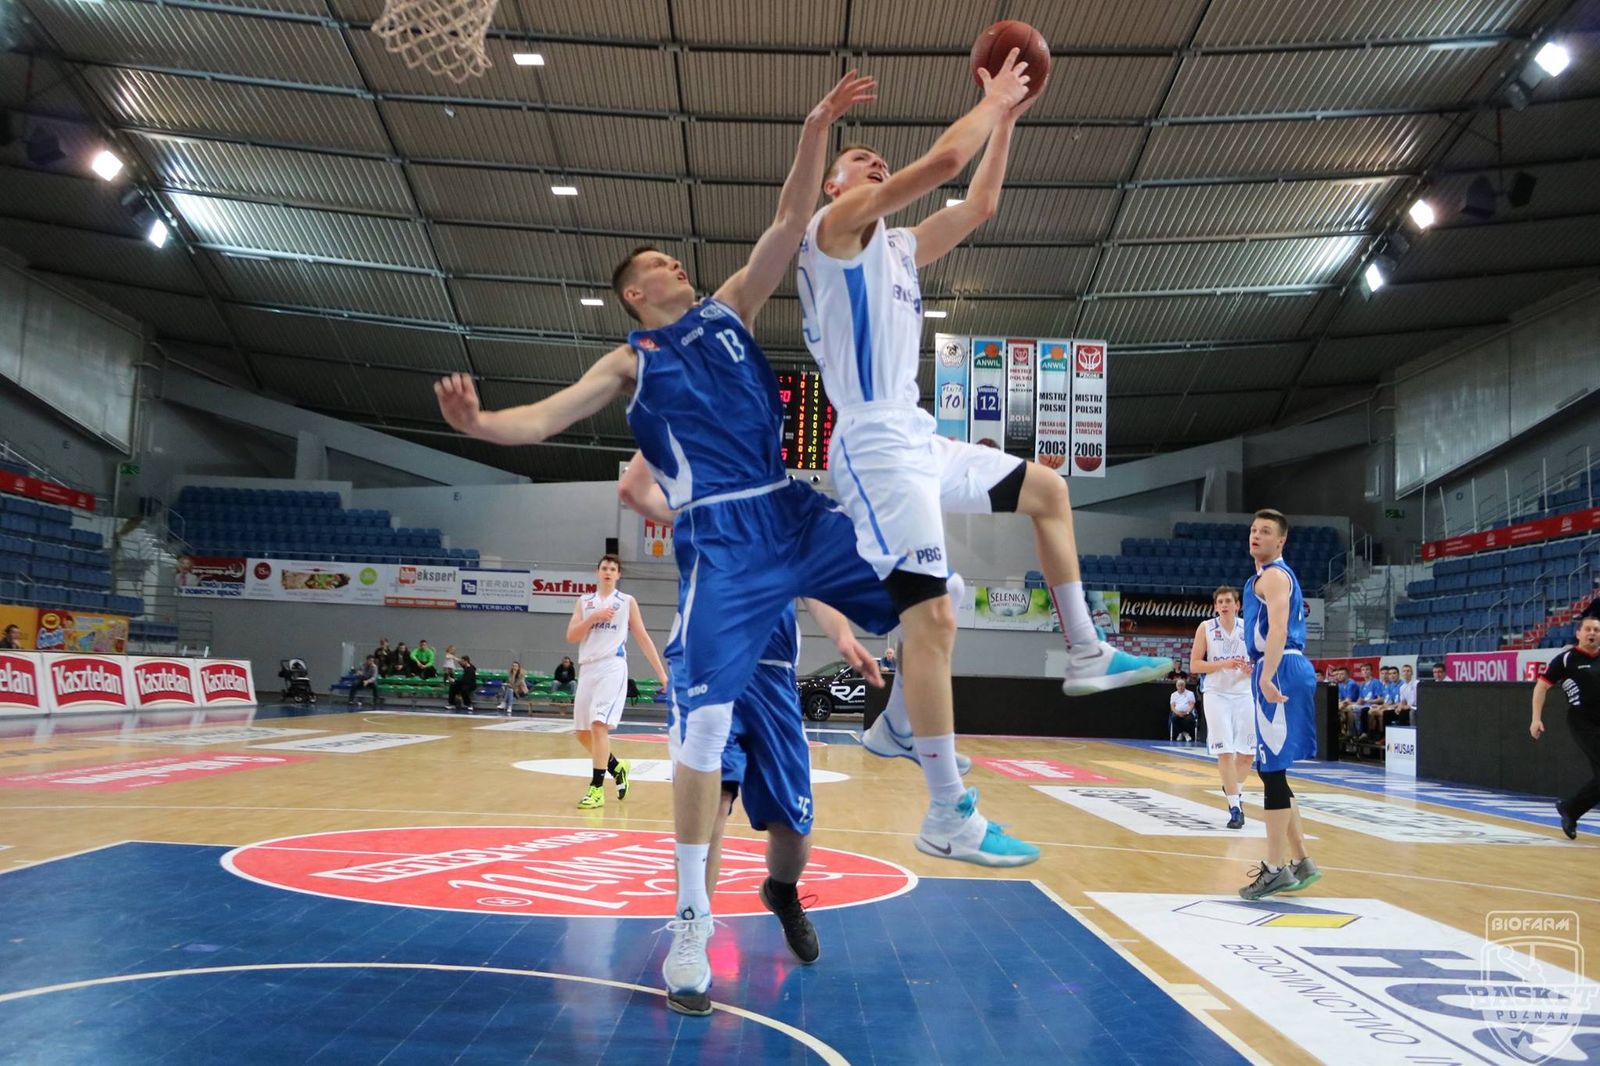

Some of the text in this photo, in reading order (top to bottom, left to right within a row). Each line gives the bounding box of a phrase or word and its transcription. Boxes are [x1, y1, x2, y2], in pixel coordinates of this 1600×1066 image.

[715, 328, 745, 364] 13
[976, 359, 1001, 367] ANWIL
[1041, 361, 1066, 370] ANWIL
[945, 394, 961, 409] 10
[980, 395, 997, 411] 12
[1039, 392, 1067, 401] MISTRZ
[1074, 393, 1103, 402] MISTRZ
[1039, 403, 1066, 412] POLSKI
[1075, 405, 1102, 414] POLSKI
[1038, 440, 1066, 455] 2003
[1074, 442, 1103, 457] 2006
[916, 547, 942, 564] PBG
[480, 580, 525, 589] TERBUD
[990, 592, 1027, 604] SELENKA
[1453, 660, 1508, 682] TAURON
[53, 664, 122, 695] Kasztelan
[137, 667, 190, 695] Kasztelan
[202, 669, 249, 693] Kasztelan
[1394, 744, 1415, 755] HUSAR
[320, 850, 502, 881] ORLEN
[1221, 944, 1422, 1045] BUDOWNICTWO
